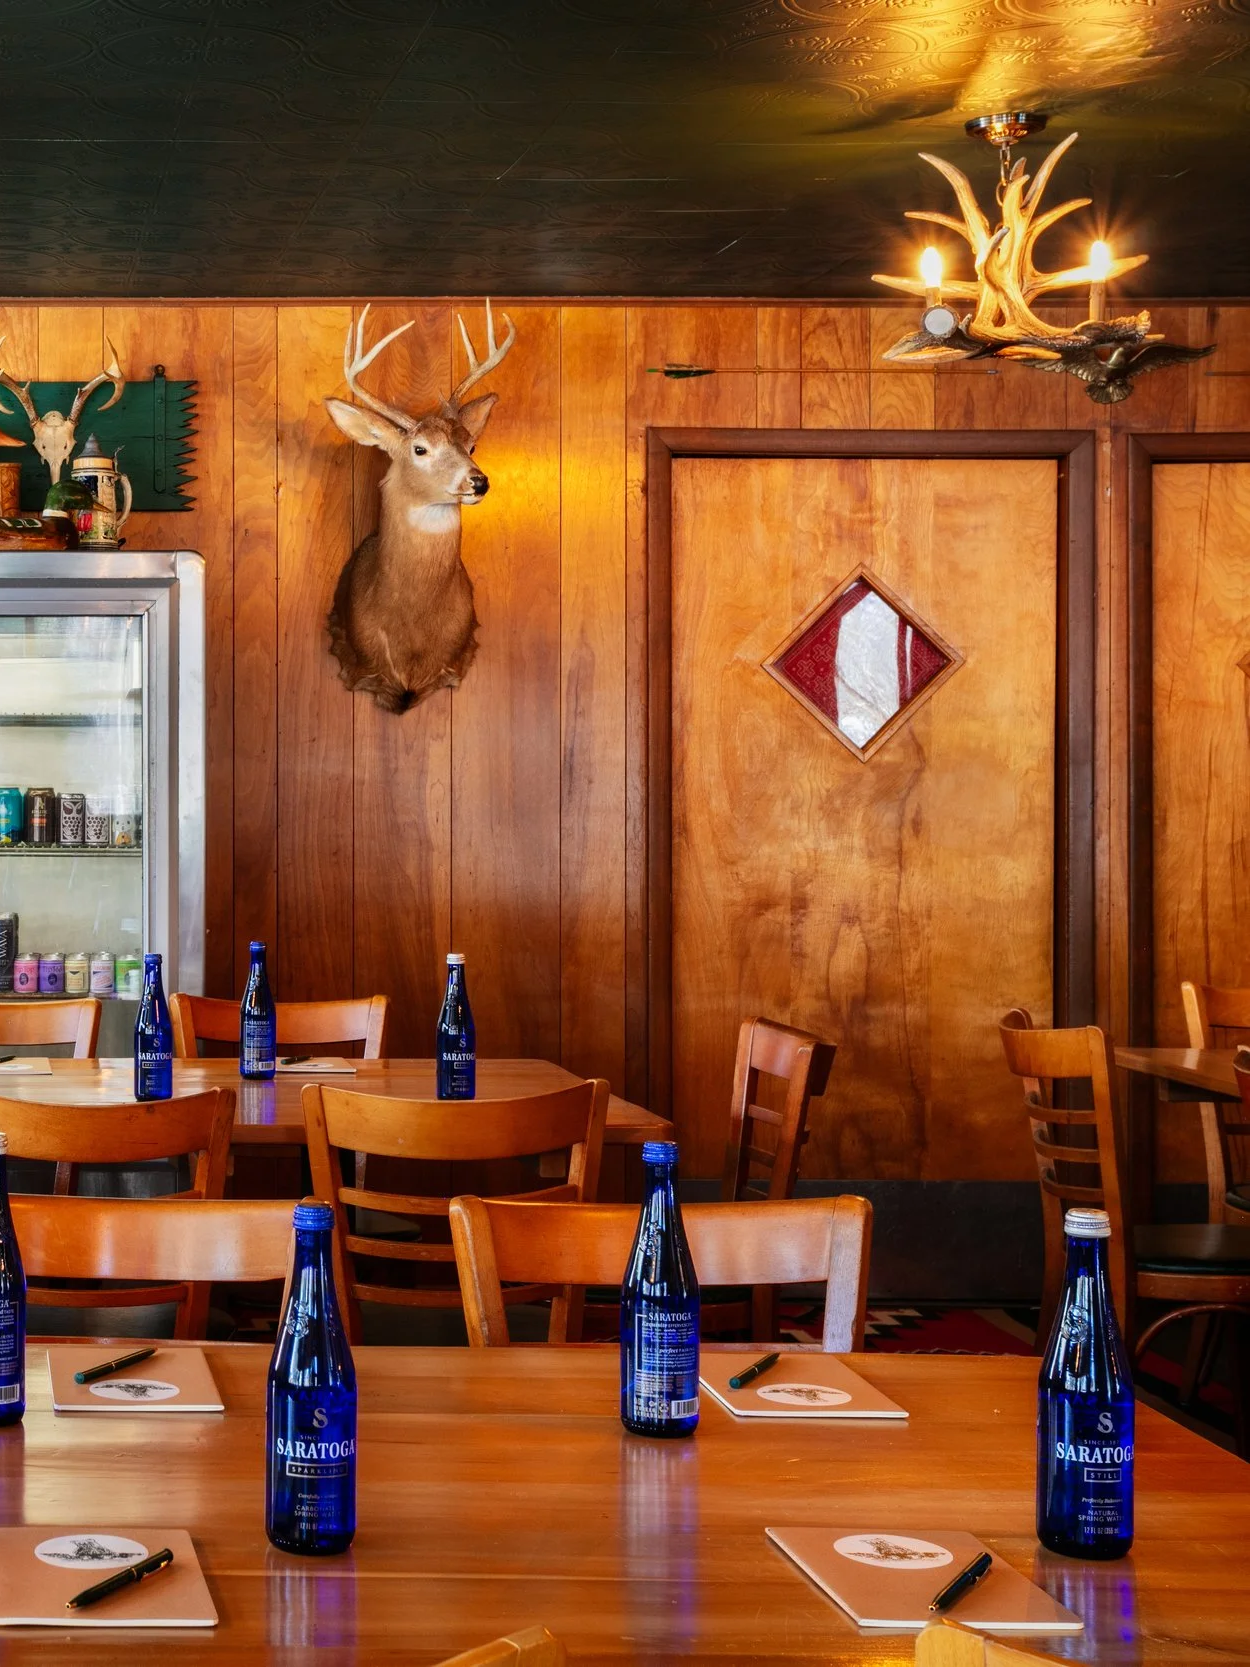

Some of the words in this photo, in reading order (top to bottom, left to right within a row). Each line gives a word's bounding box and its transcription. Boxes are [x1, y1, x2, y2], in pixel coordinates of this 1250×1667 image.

[153, 1037, 160, 1047] S
[459, 1038, 467, 1047] S
[442, 1052, 476, 1061] SARATOG
[648, 1312, 692, 1322] SARATOGA
[312, 1407, 329, 1428] S
[1097, 1412, 1114, 1433] S
[277, 1437, 355, 1459] SARATOGA
[1078, 1514, 1105, 1522] SPRING
